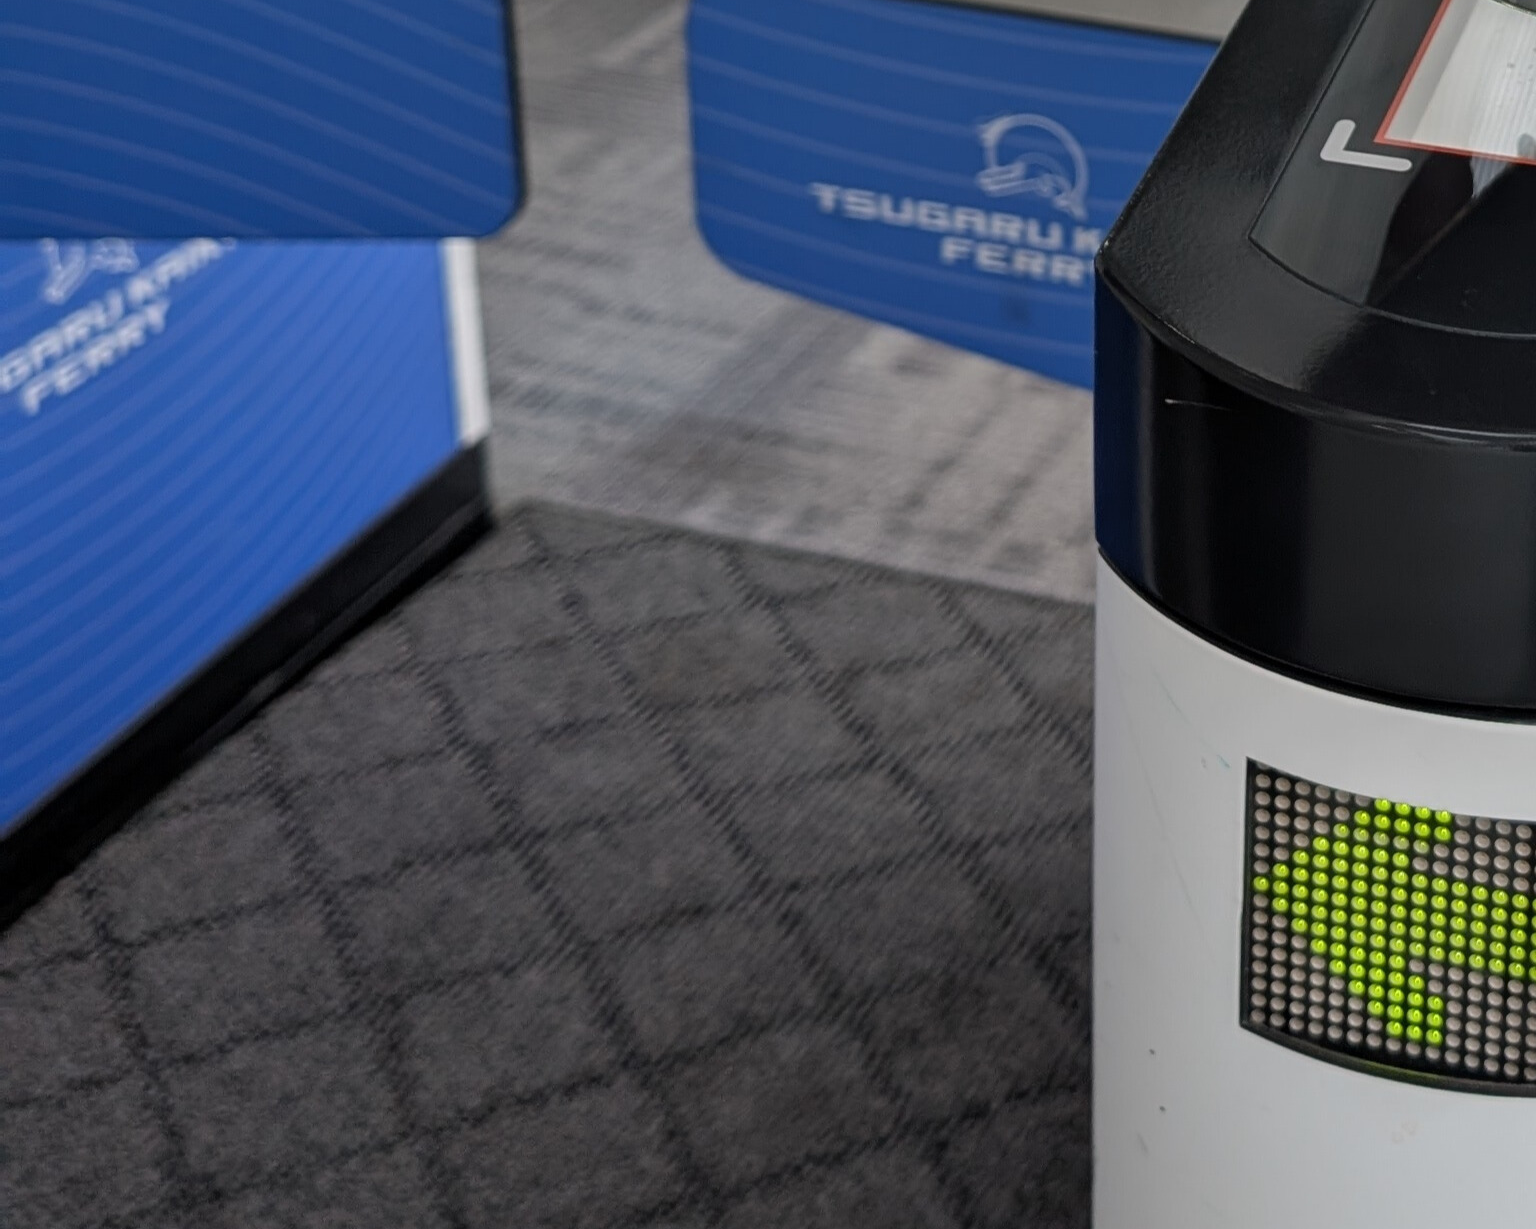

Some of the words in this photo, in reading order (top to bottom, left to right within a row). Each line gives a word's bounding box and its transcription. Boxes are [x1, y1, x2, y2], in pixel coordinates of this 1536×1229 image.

[810, 182, 1064, 250] TSUGARU
[940, 235, 1095, 287] FERR
[21, 295, 169, 416] FERRY
